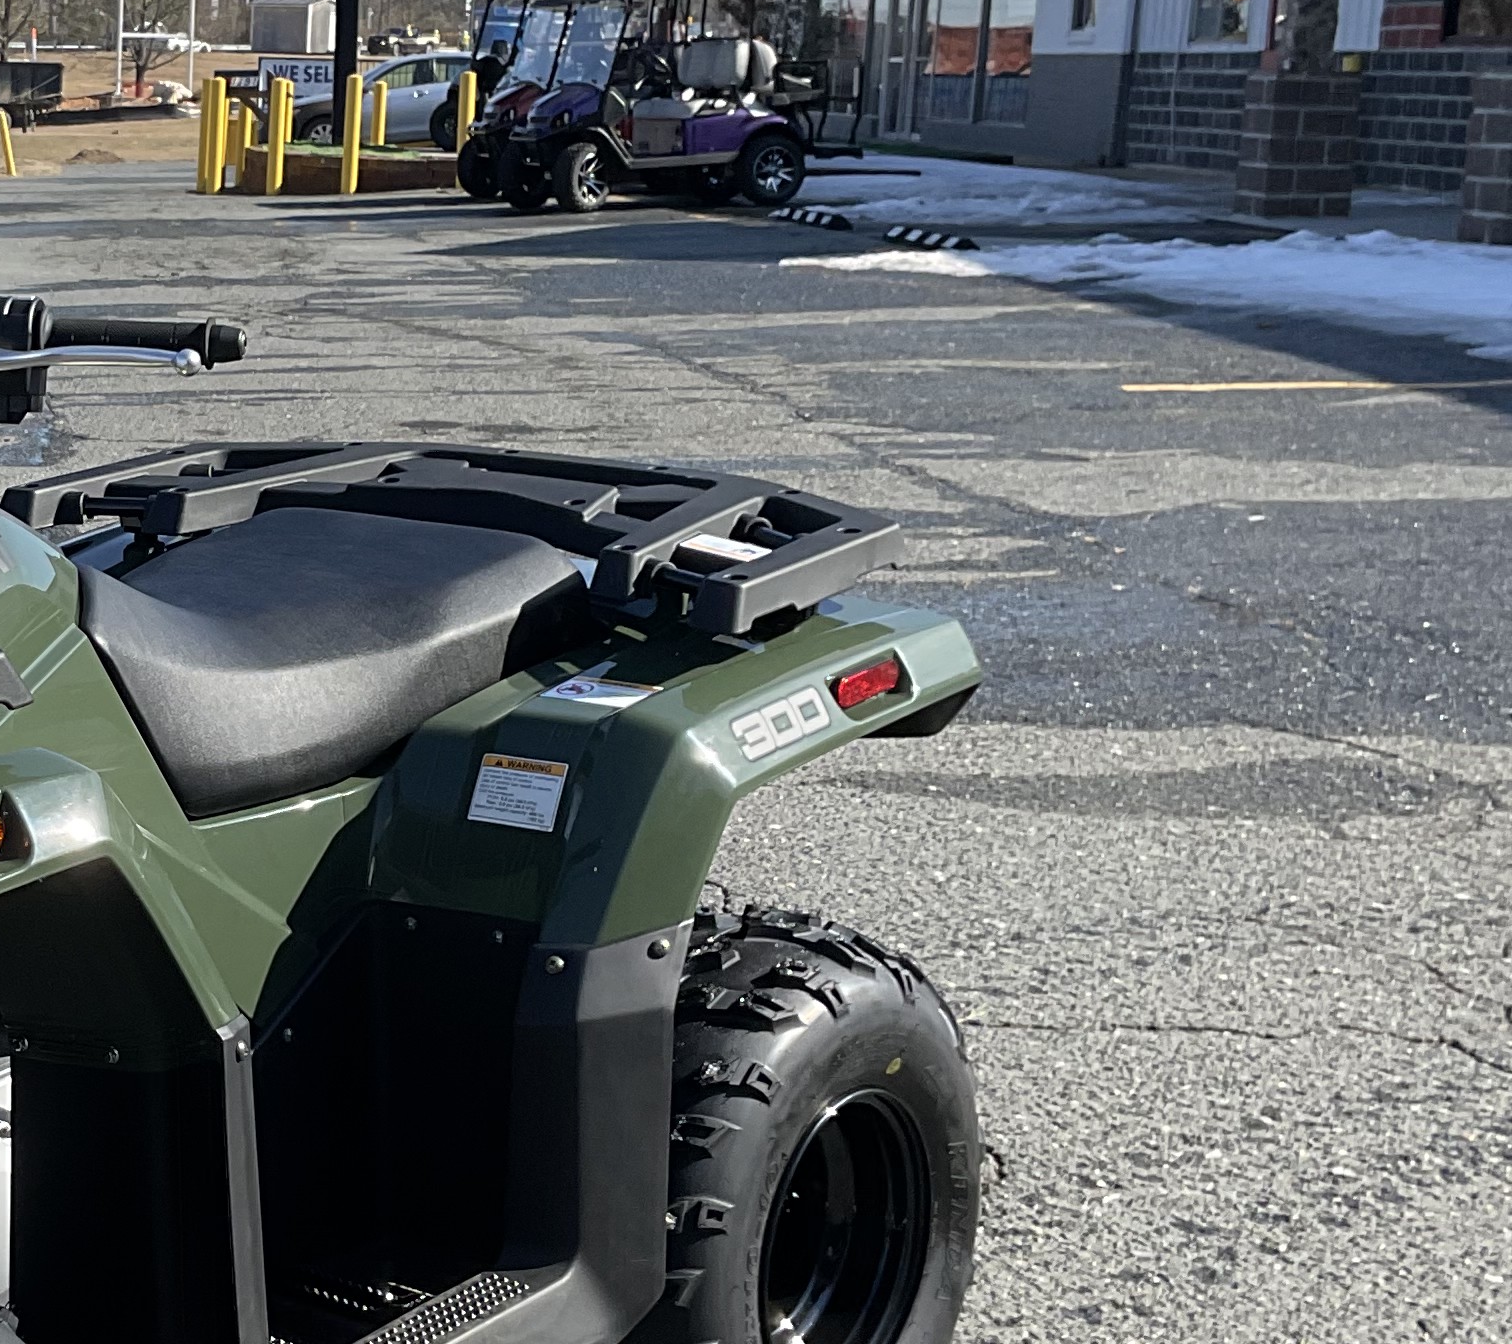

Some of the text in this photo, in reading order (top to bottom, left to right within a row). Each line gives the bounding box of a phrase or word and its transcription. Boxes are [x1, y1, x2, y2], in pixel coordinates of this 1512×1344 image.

[273, 64, 334, 83] WE SEL
[730, 684, 832, 762] 300
[506, 758, 553, 774] WARNING
